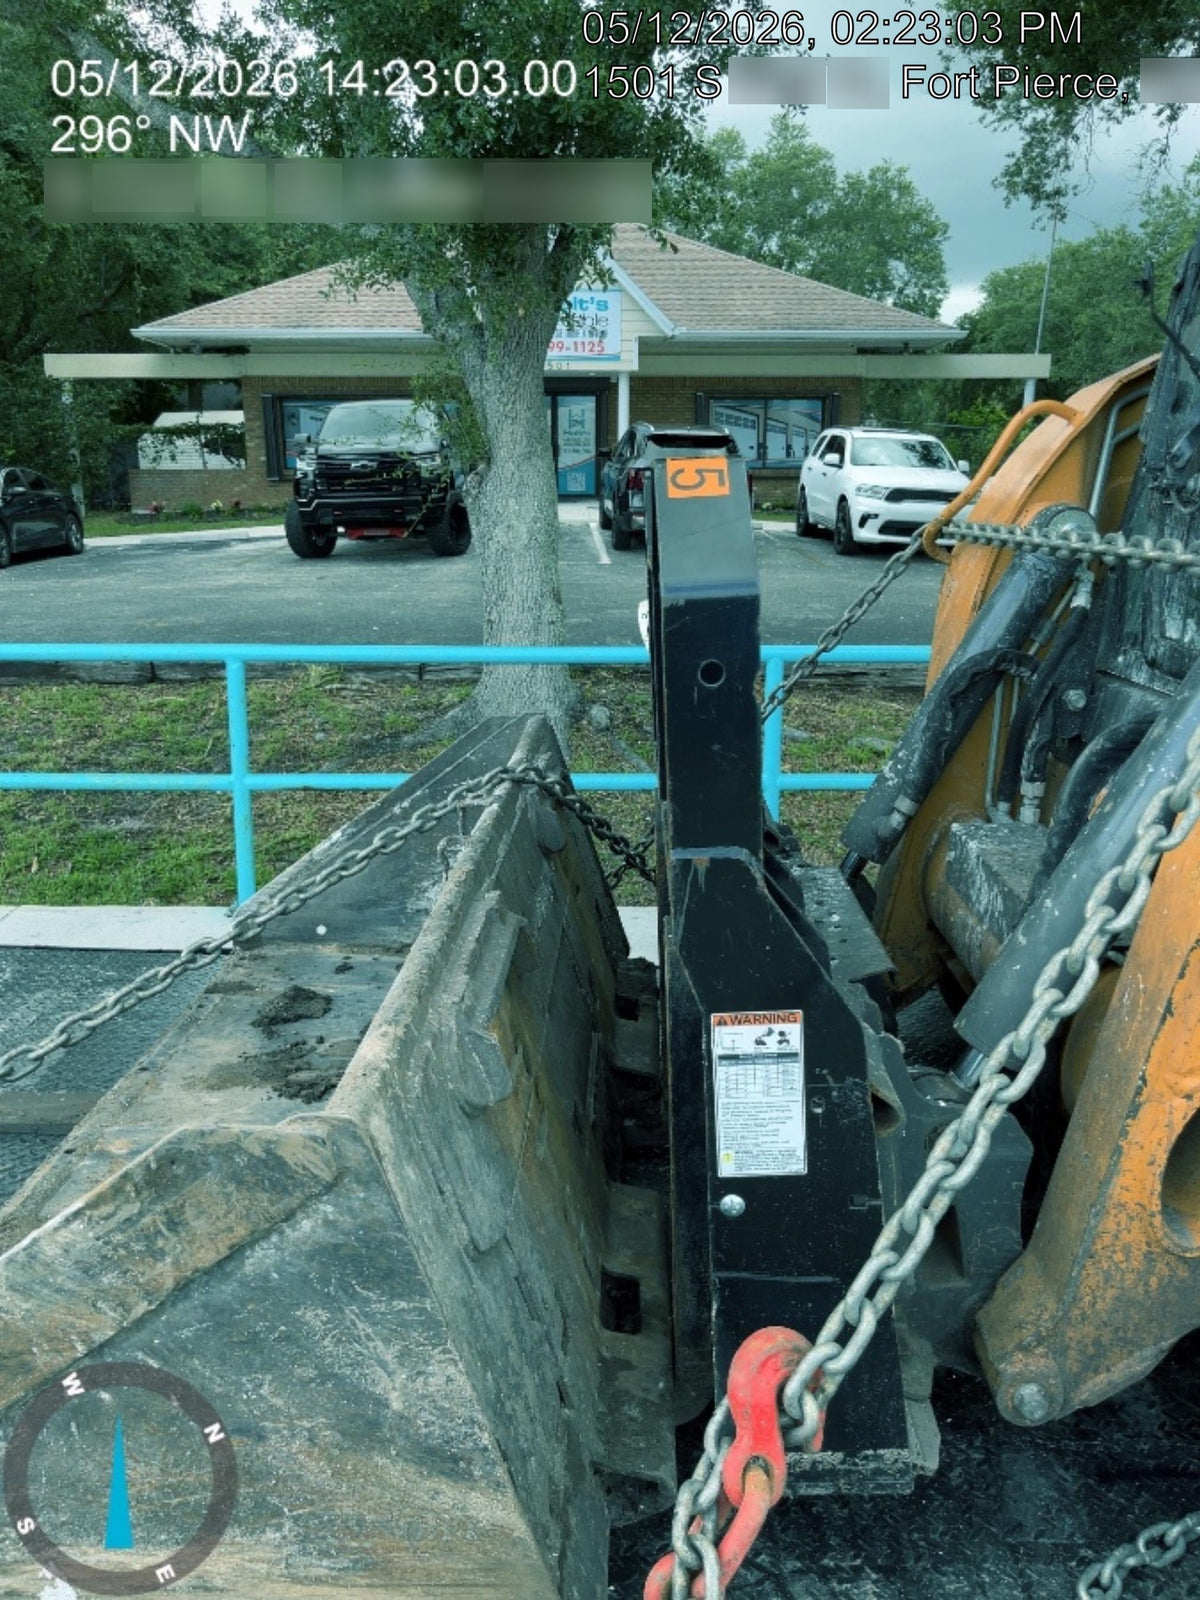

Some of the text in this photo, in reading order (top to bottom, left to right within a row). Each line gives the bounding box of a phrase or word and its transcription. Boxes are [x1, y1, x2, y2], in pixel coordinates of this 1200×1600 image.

[572, 296, 609, 312] lt's
[548, 341, 605, 353] 99-1125
[670, 467, 726, 491] 5
[730, 1012, 798, 1026] WARNING
